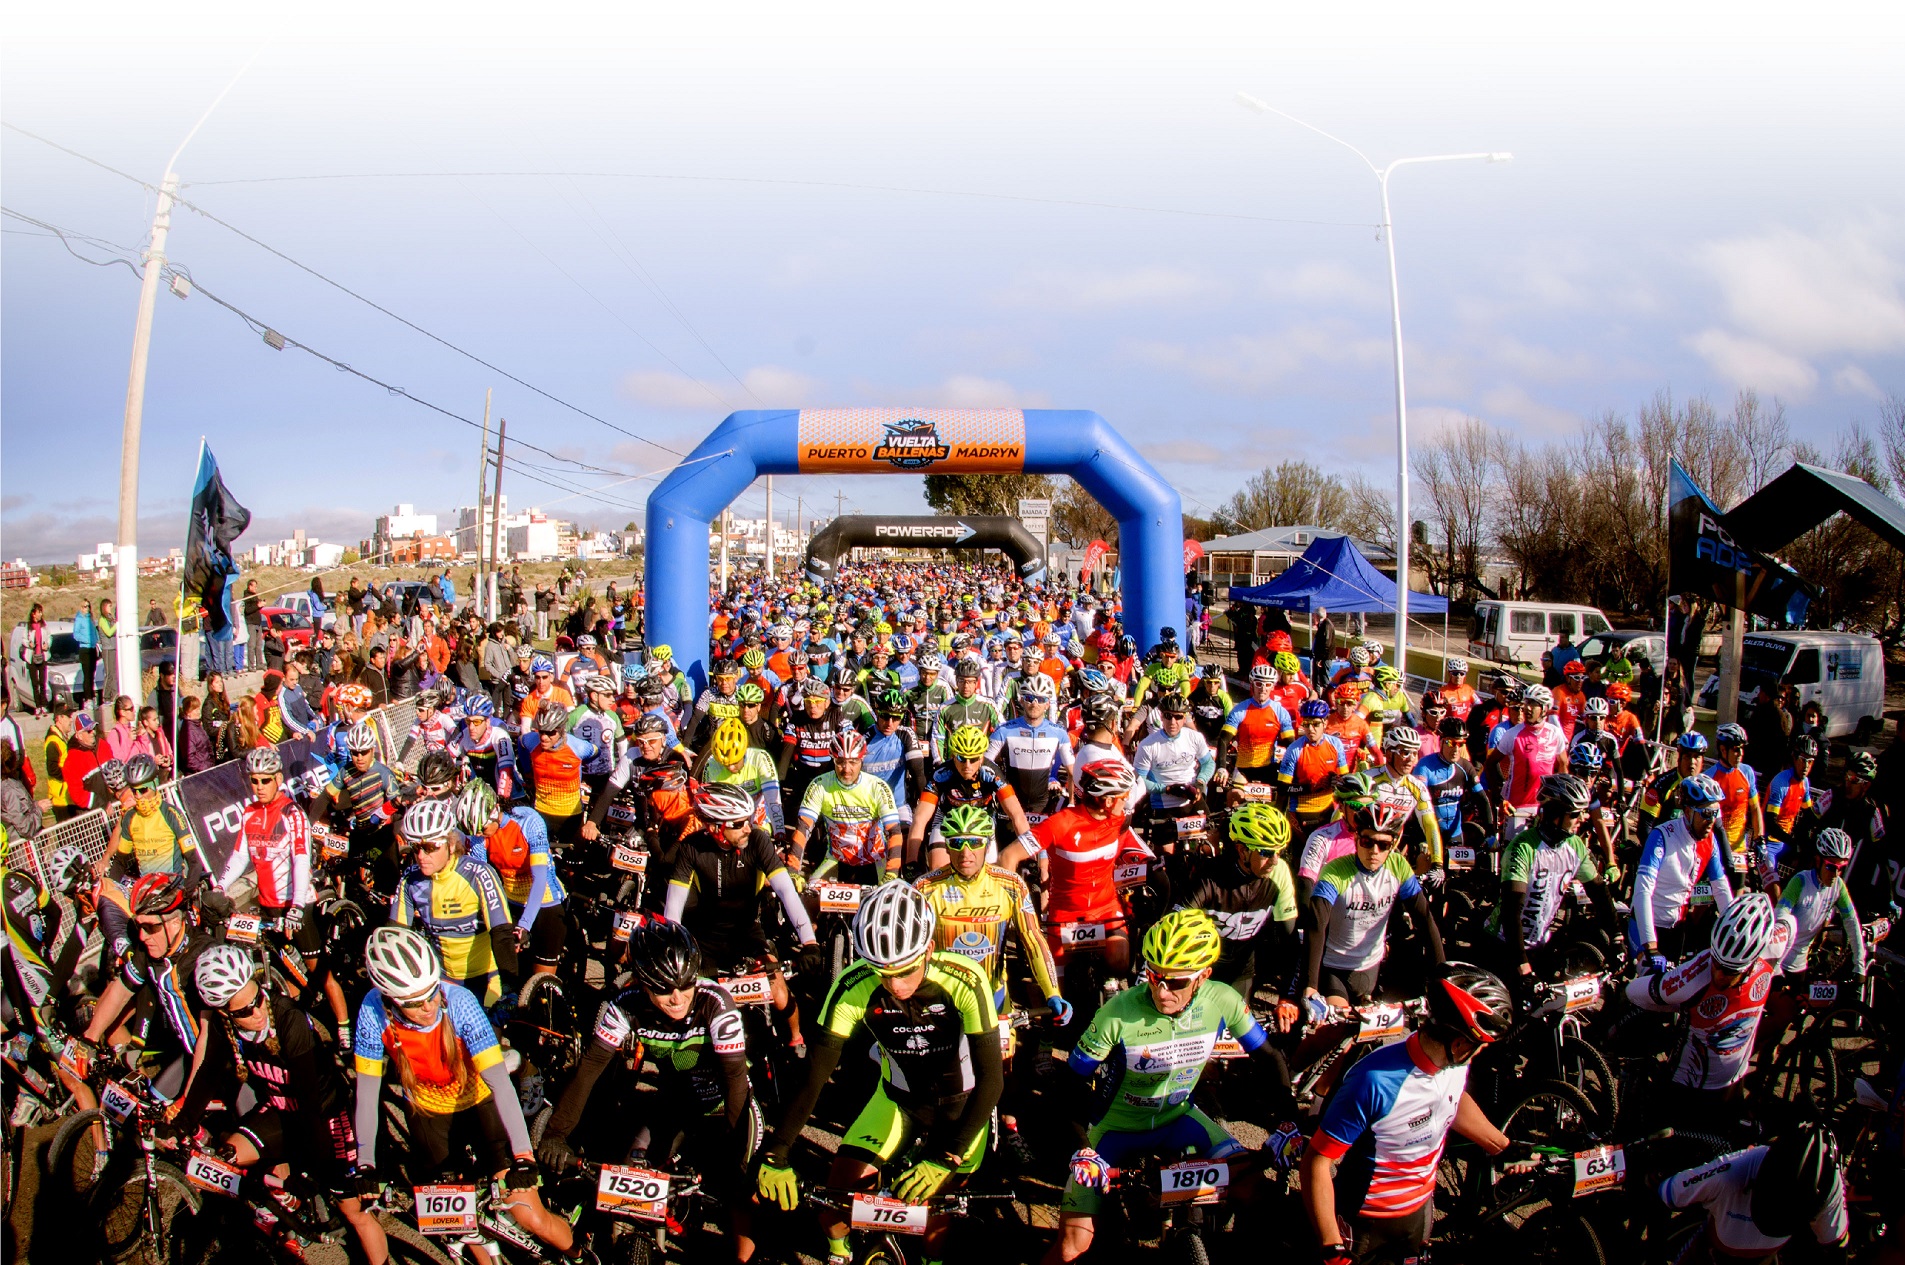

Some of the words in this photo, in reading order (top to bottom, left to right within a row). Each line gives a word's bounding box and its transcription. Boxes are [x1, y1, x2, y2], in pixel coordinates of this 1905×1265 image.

[888, 436, 936, 447] VUELTA
[807, 448, 867, 459] PUERTO
[877, 447, 946, 458] BALLENAS
[955, 447, 1020, 459] MADRYN
[876, 525, 965, 538] POWERADE
[1743, 639, 1764, 648] CALETA
[1765, 642, 1786, 652] OLIVIA
[1250, 786, 1266, 794] 601
[611, 809, 631, 820] 1107
[1182, 821, 1202, 830] 488
[327, 838, 347, 851] 1805
[618, 852, 643, 865] 1058
[1454, 850, 1470, 859] 819
[1120, 867, 1140, 879] 451
[464, 862, 500, 911] SWEDEN
[1694, 886, 1709, 895] 1813
[827, 890, 853, 901] 849
[940, 905, 1000, 917] LEMA
[971, 914, 1001, 923] TEAM
[234, 920, 254, 931] 486
[1071, 928, 1096, 942] 104
[24, 971, 43, 995] MADRYN
[730, 982, 762, 995] 408
[1813, 986, 1835, 998] 1809
[1376, 1014, 1390, 1027] 19
[637, 1027, 706, 1041] CANNOALE
[714, 1041, 744, 1051] RAM
[1179, 1040, 1205, 1048] REGIONAL
[105, 1089, 131, 1112] 1054
[1586, 1155, 1616, 1176] 634
[195, 1162, 234, 1189] 1536
[1172, 1168, 1220, 1188] 1810
[1616, 1172, 1625, 1182] P
[1683, 1162, 1733, 1188] venzo
[608, 1175, 660, 1198] 1520
[425, 1196, 467, 1213] 1610
[653, 1202, 664, 1213] P
[432, 1217, 460, 1225] LOVERA
[464, 1214, 475, 1226] P
[872, 1207, 909, 1223] 116
